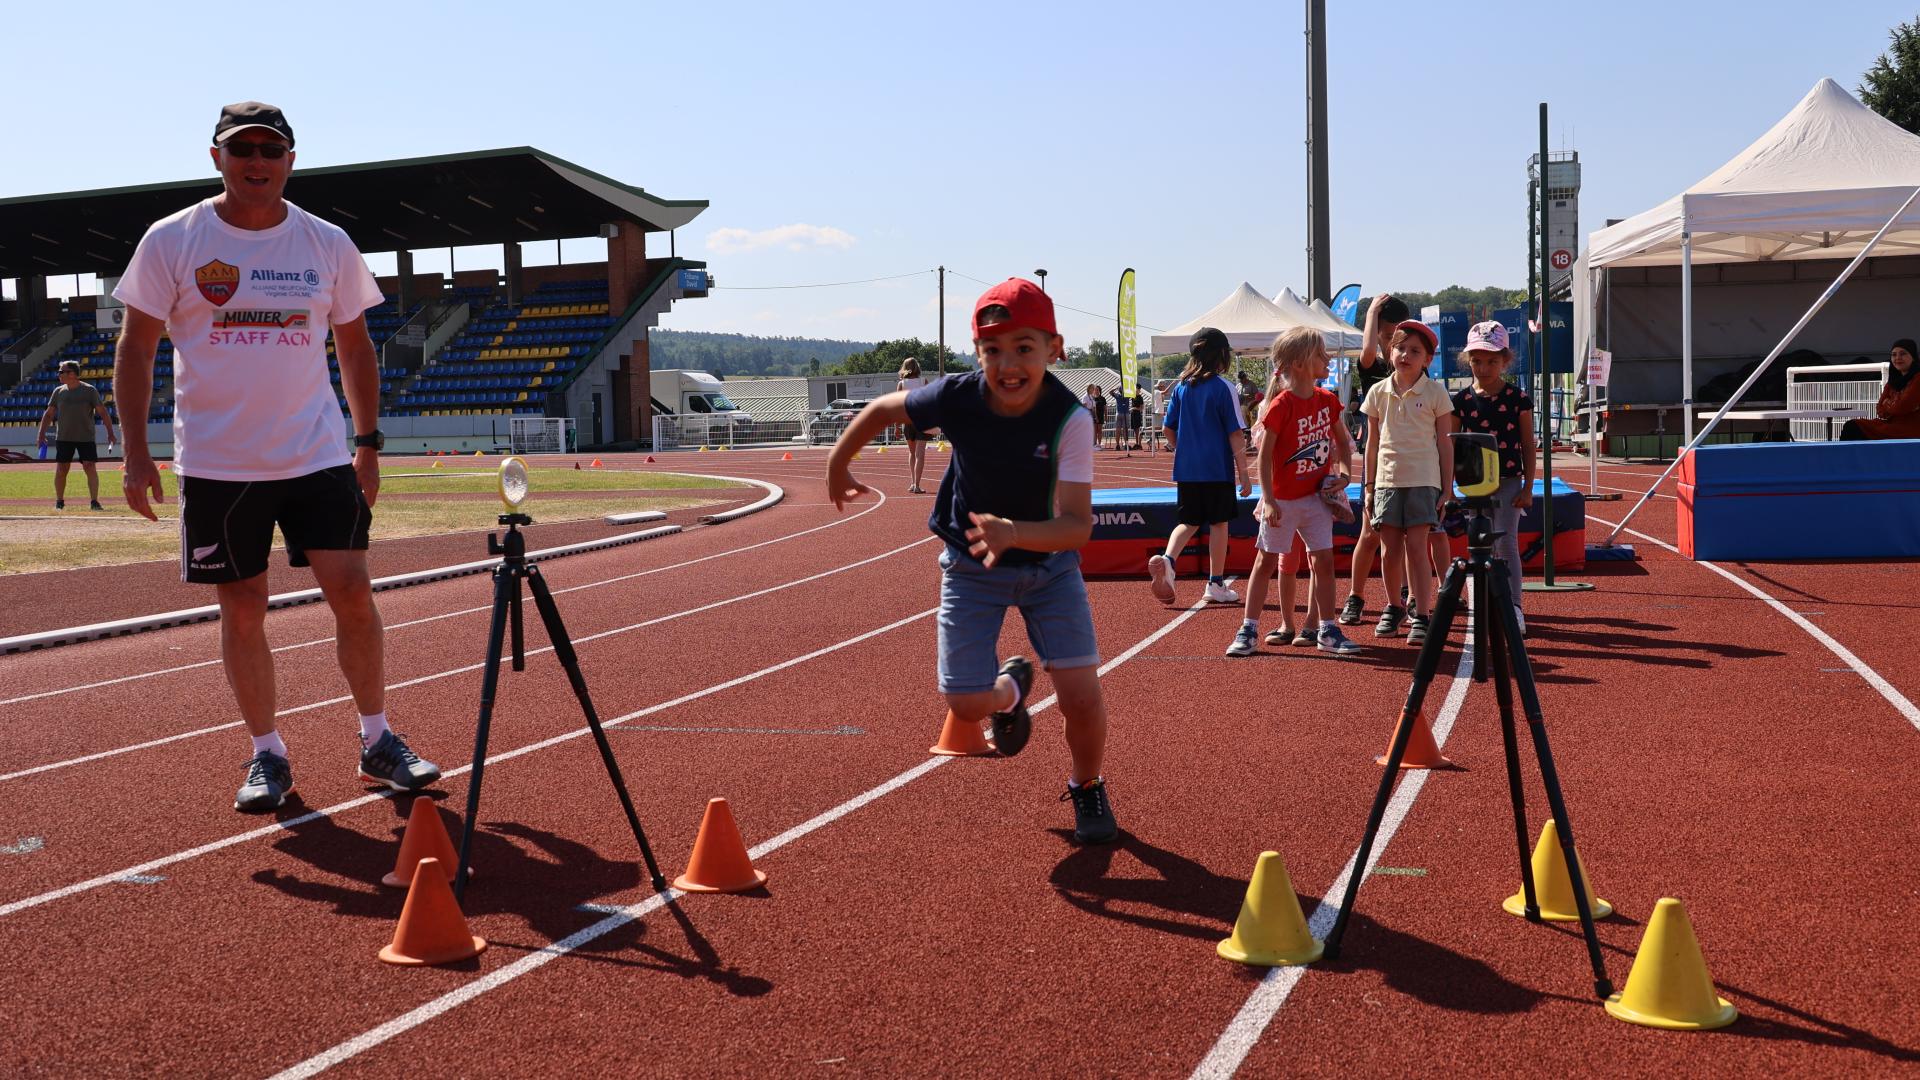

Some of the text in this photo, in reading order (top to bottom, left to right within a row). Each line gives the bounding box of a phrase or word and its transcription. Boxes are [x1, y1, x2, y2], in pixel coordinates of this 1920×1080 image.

[1553, 254, 1569, 265] 18
[250, 269, 302, 282] Allianz
[223, 311, 285, 328] MUNIER
[208, 331, 311, 346] STAFF ACN
[1297, 406, 1331, 434] PLAY
